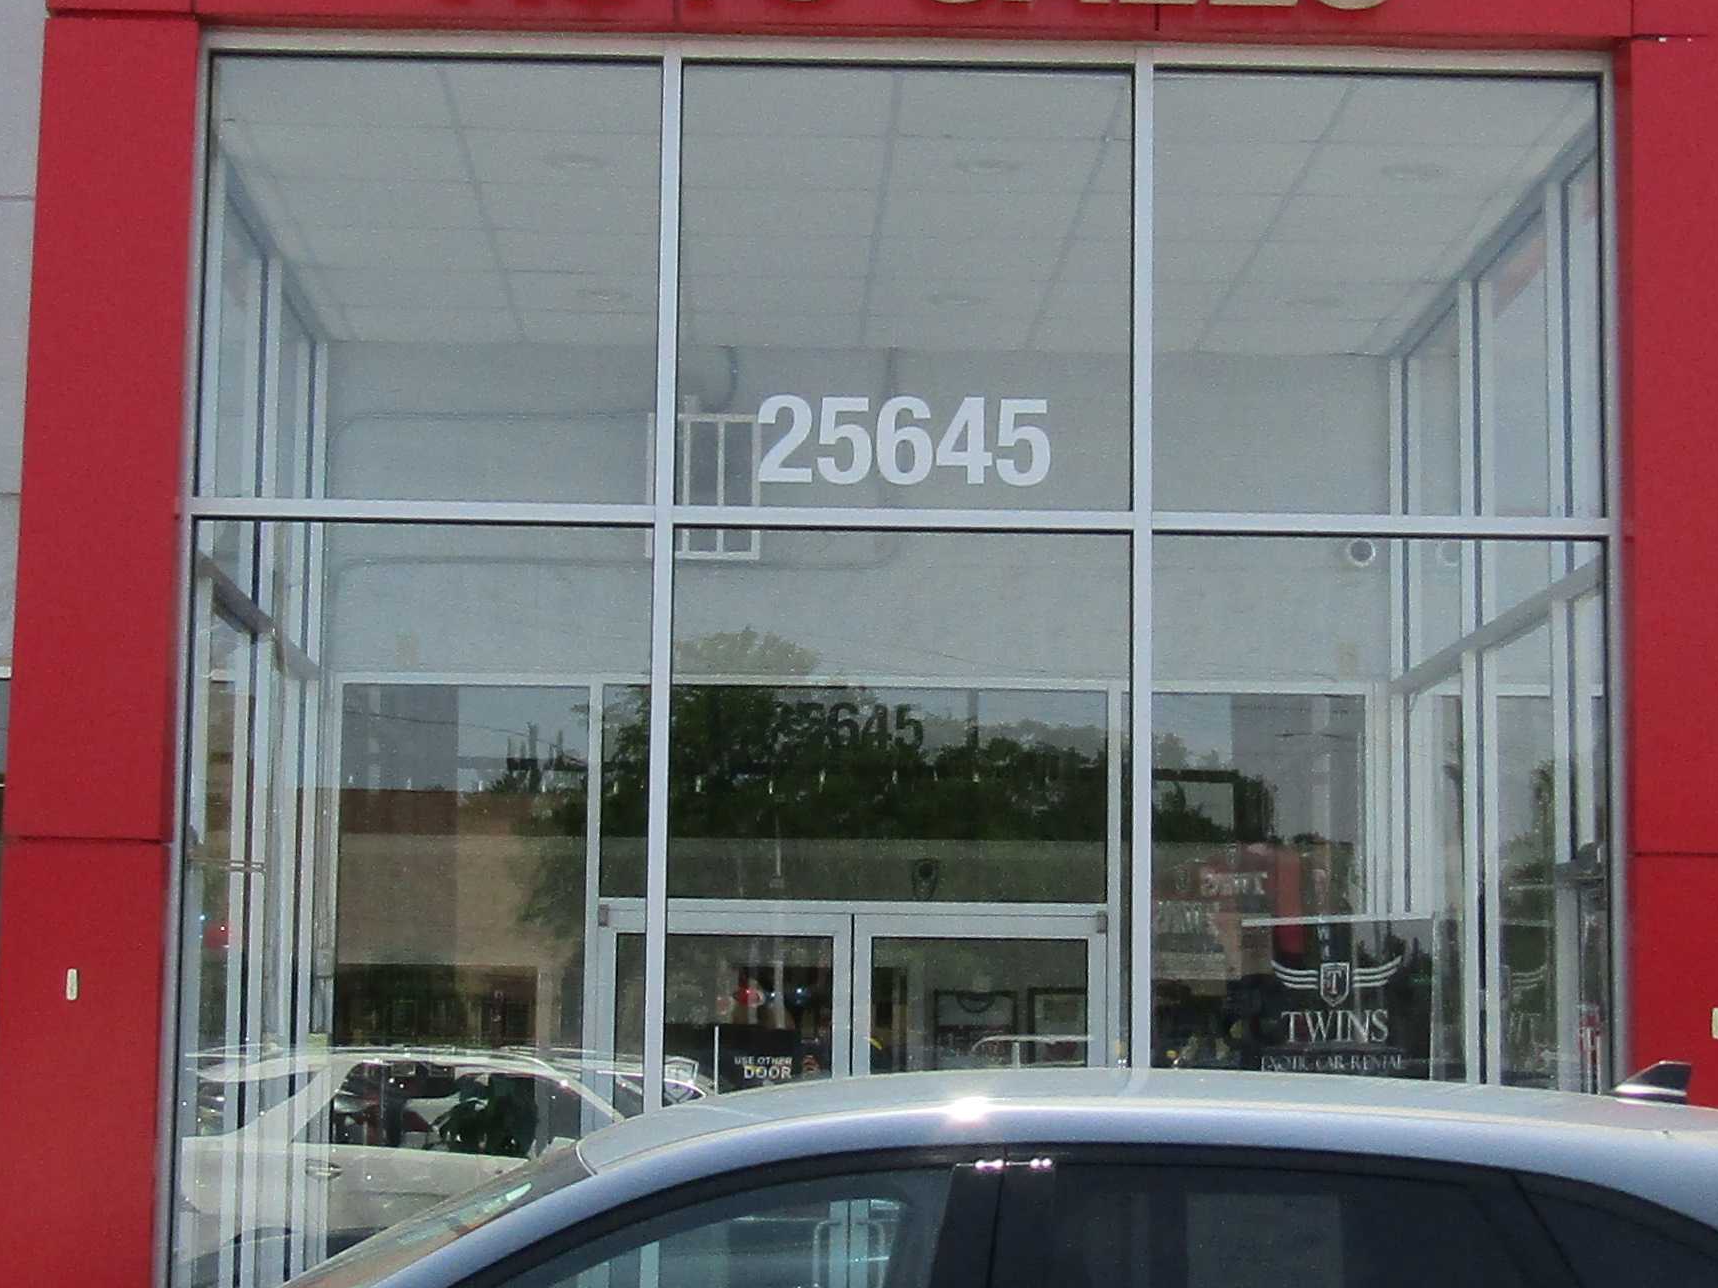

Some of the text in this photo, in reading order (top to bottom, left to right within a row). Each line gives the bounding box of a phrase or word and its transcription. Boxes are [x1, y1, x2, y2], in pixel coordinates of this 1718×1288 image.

[757, 393, 1052, 487] 25645
[1280, 1008, 1390, 1044] TWINS
[743, 1065, 793, 1080] DOOR
